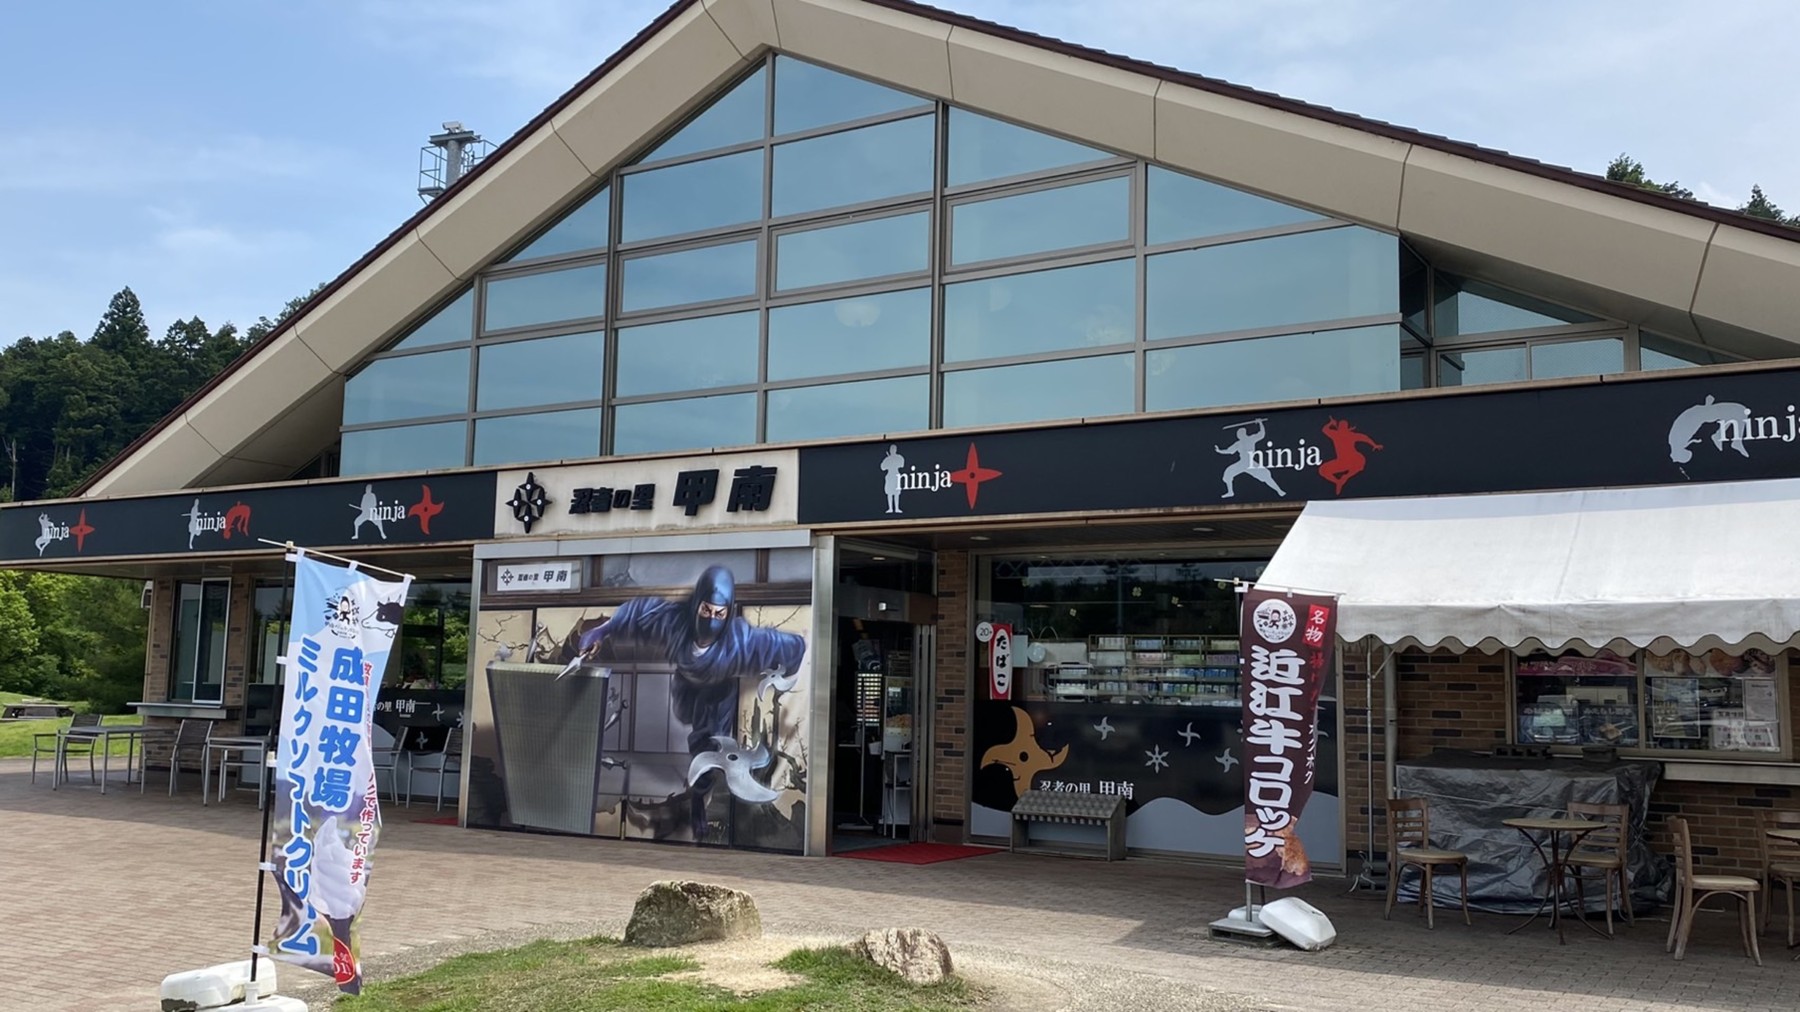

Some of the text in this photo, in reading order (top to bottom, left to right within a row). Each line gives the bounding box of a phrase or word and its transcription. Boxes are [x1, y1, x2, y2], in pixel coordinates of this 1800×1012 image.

[1717, 405, 1800, 442] ninj
[1247, 438, 1323, 471] ninja
[568, 464, 778, 516] 忍者の里 甲南
[895, 463, 953, 492] ninja
[196, 511, 226, 532] ninja
[369, 499, 406, 523] ninja
[44, 521, 70, 541] ninja
[543, 570, 569, 583] 甲南
[1305, 609, 1325, 642] 名物
[996, 635, 1010, 687] たばこ
[396, 699, 416, 713] 甲南
[310, 646, 364, 809] 成田牧場
[1245, 645, 1306, 858] 近江牛コロッケ
[280, 637, 321, 955] ミルクソフトクリーム
